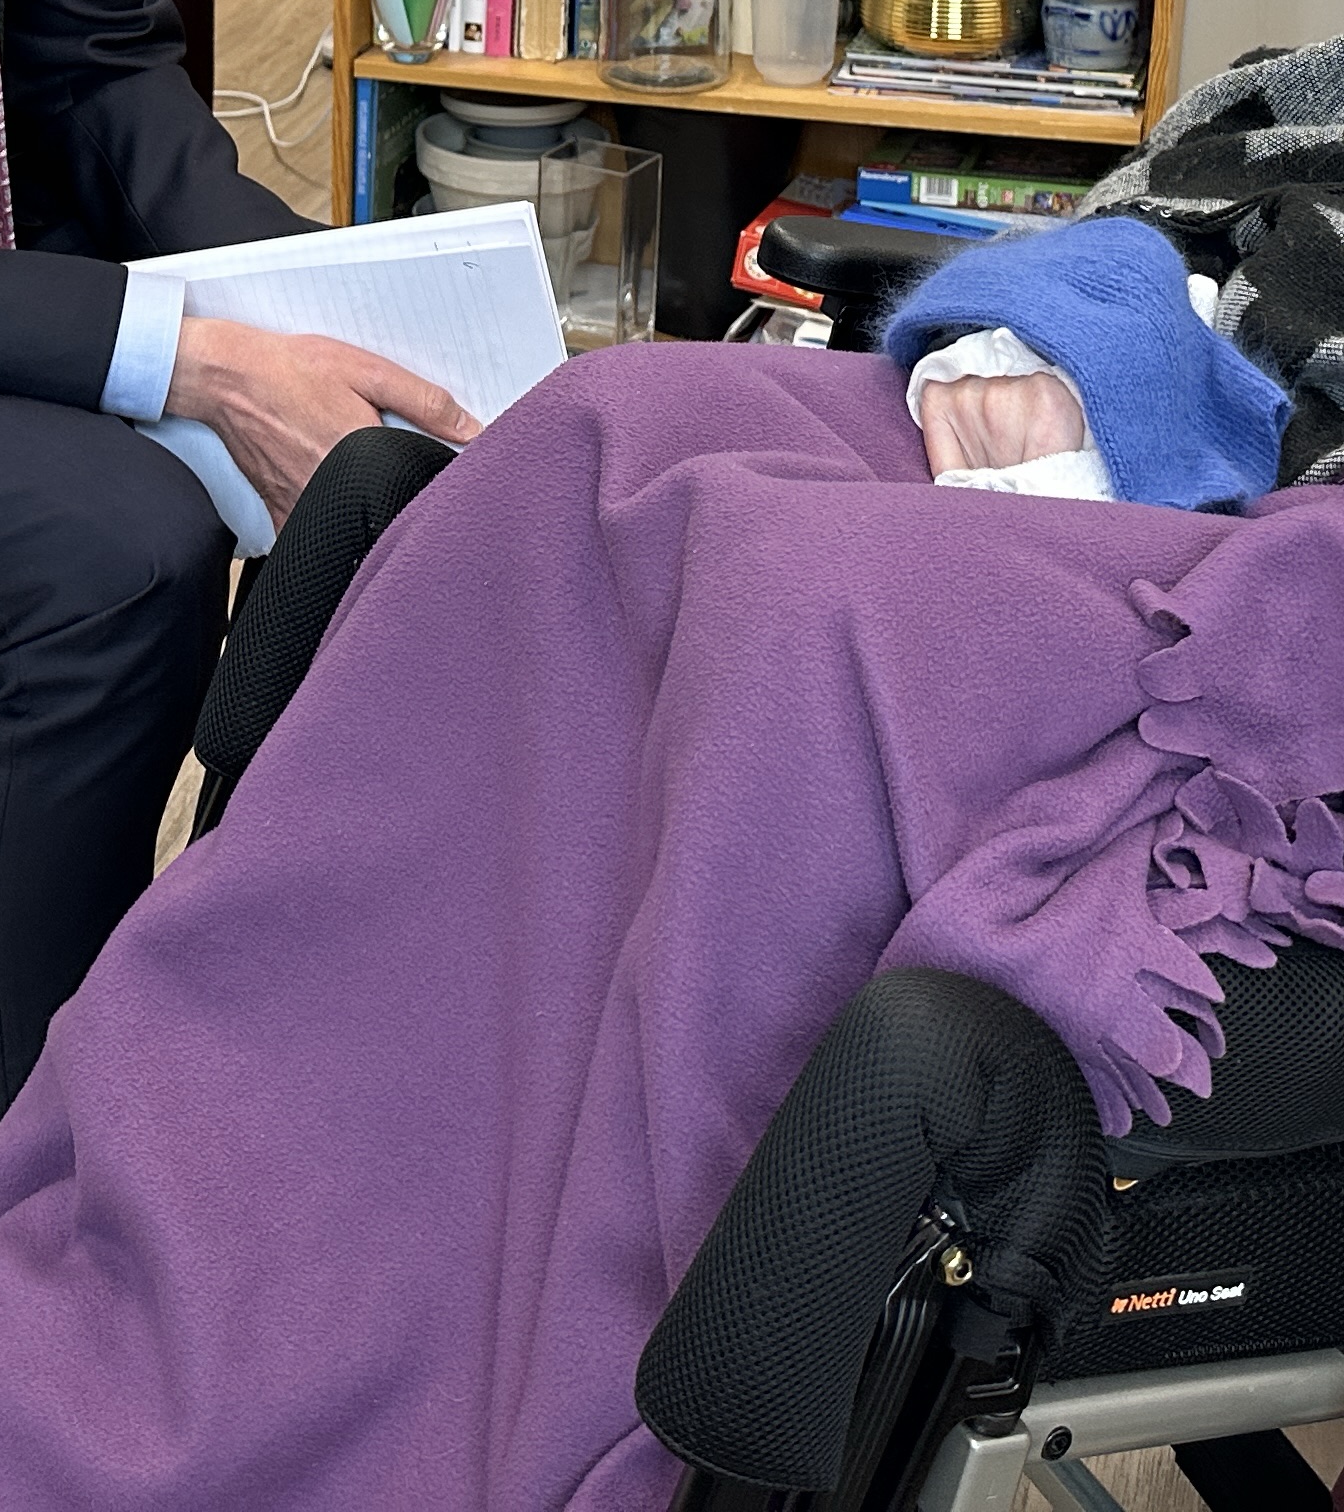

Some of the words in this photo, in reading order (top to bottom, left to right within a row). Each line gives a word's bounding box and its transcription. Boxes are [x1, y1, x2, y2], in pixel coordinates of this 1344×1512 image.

[1128, 1288, 1177, 1312] Netti
[1178, 1290, 1208, 1305] Uno
[1210, 1283, 1245, 1301] Seat
